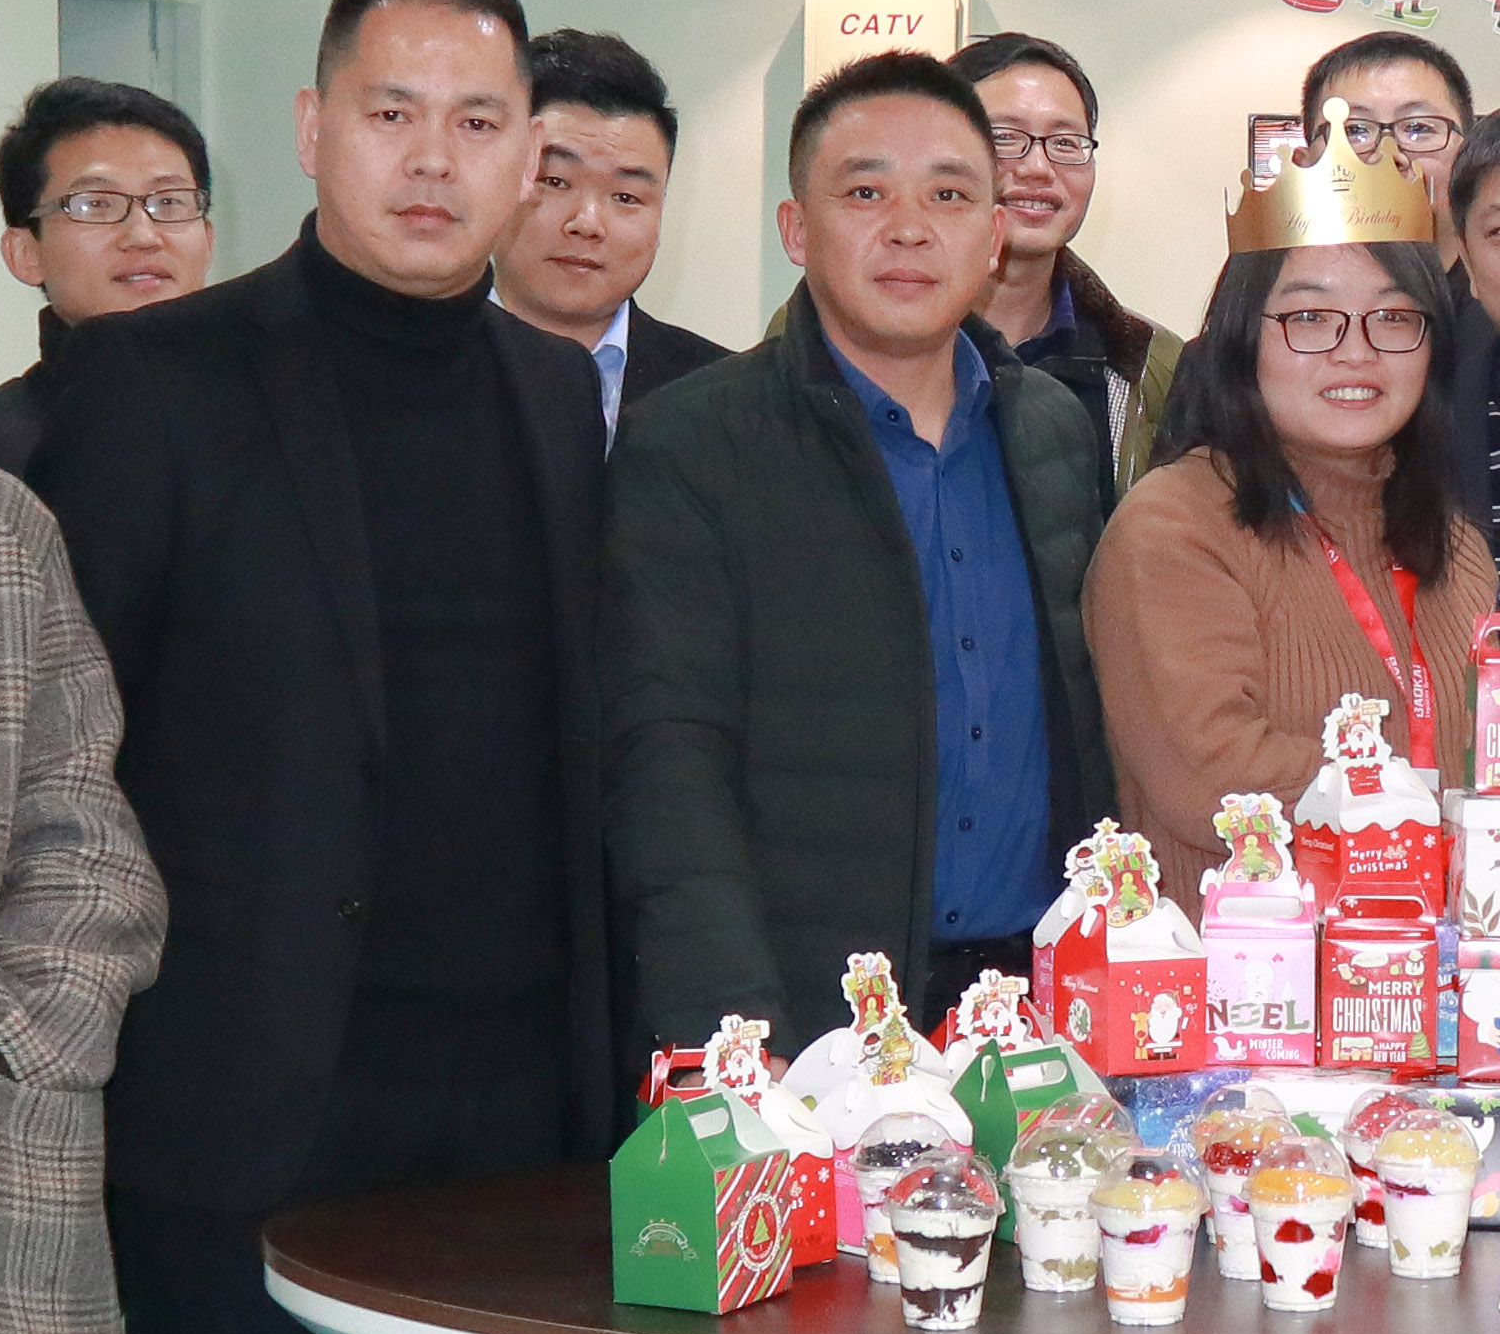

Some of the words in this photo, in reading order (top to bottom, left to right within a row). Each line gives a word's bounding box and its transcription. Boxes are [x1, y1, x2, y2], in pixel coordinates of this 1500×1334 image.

[840, 13, 924, 35] CATV
[1342, 206, 1402, 229] Birthday
[1349, 849, 1382, 860] Merry
[1348, 859, 1408, 874] Christmas
[1368, 979, 1424, 995] MERRY
[1206, 999, 1310, 1031] NOEL
[1332, 997, 1422, 1033] CHRISTMAS
[1249, 1039, 1284, 1050] WINTER
[1265, 1049, 1300, 1060] COMING
